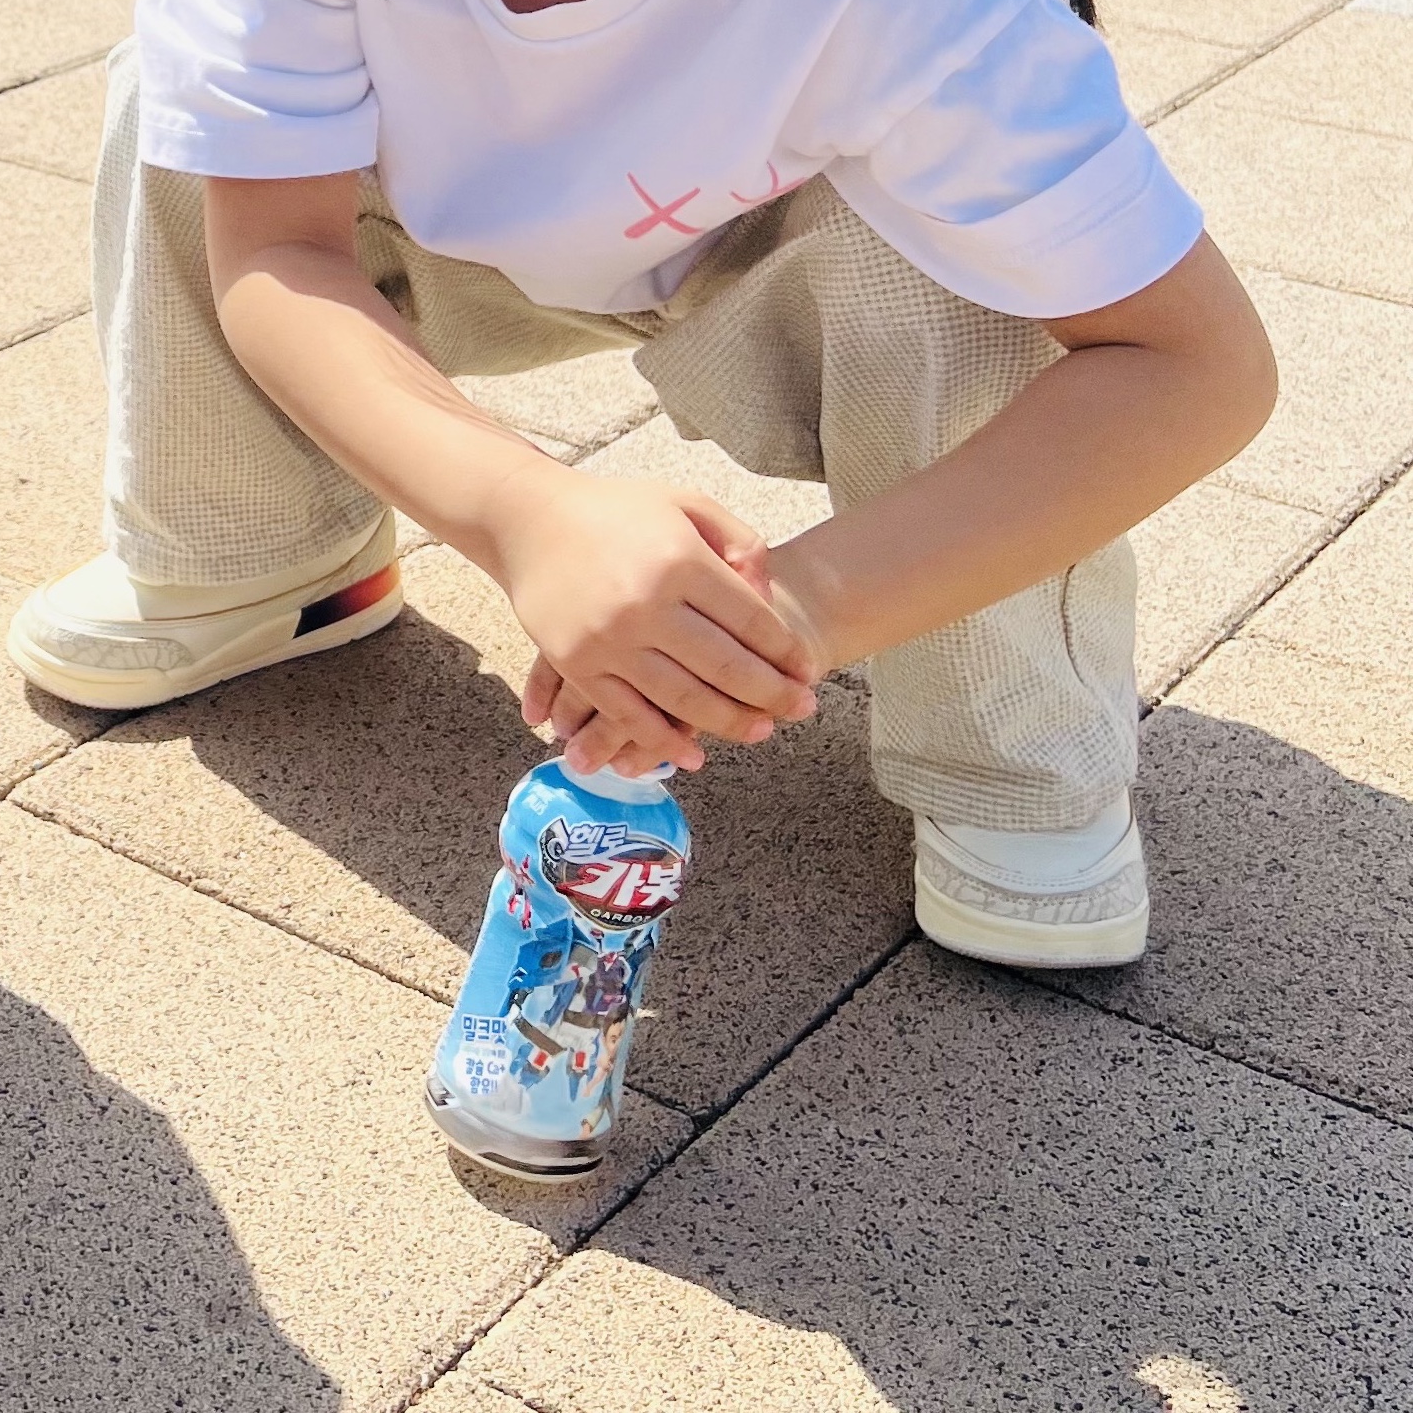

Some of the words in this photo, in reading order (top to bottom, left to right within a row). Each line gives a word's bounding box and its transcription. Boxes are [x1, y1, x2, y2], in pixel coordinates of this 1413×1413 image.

[563, 823, 630, 860] 헬로
[568, 861, 683, 907] 카봇
[590, 908, 652, 925] CARBOT
[463, 1016, 508, 1044] 밀크맛
[465, 1058, 484, 1076] 칼슘
